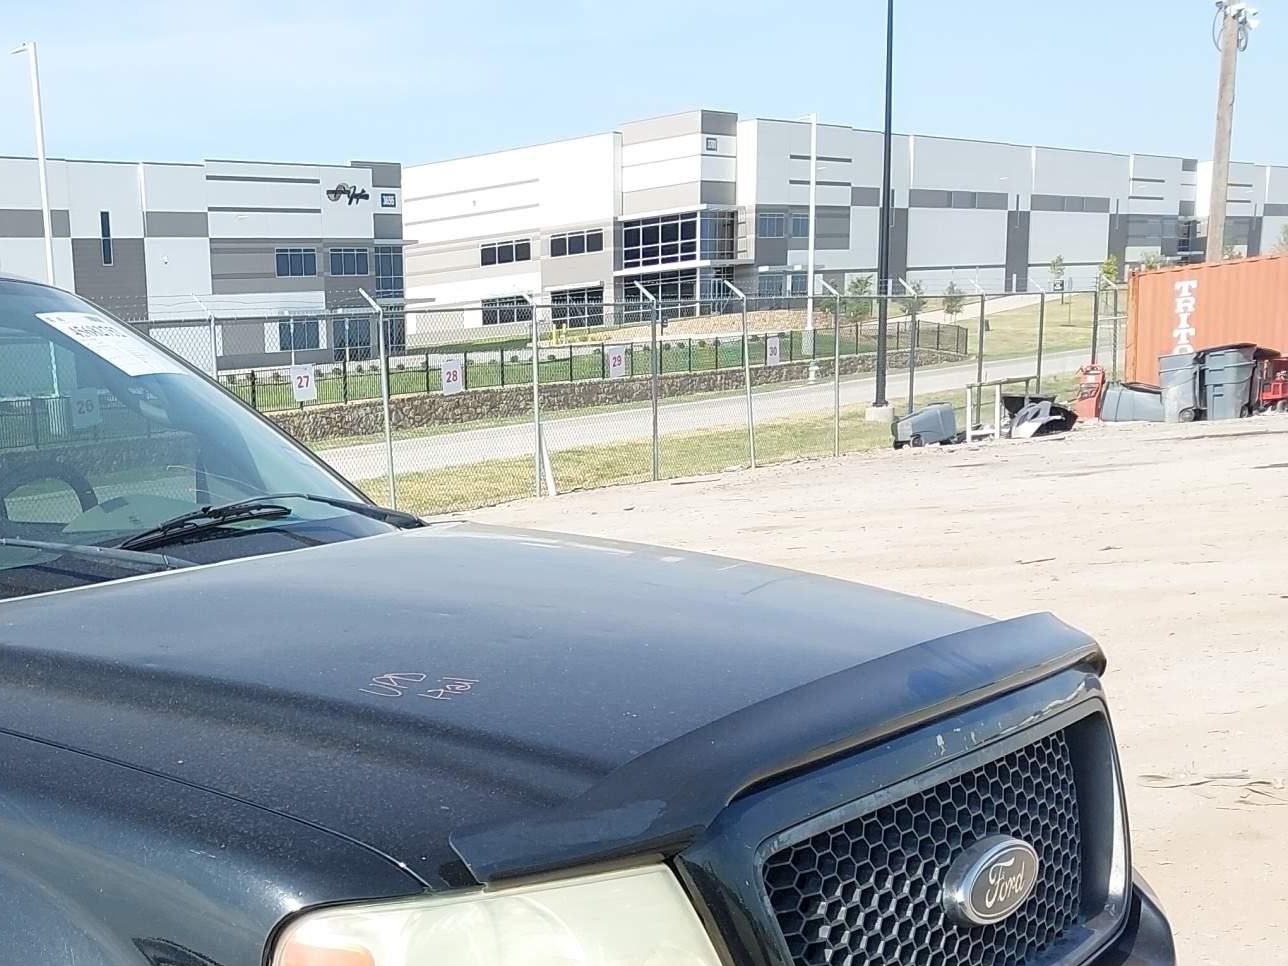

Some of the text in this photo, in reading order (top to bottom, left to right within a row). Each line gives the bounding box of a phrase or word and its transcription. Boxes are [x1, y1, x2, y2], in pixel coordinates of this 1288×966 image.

[770, 346, 778, 357] 30
[612, 355, 622, 368] 29
[297, 375, 310, 389] 27
[446, 370, 458, 384] 28
[77, 399, 95, 415] 26
[985, 857, 1026, 909] Ford
